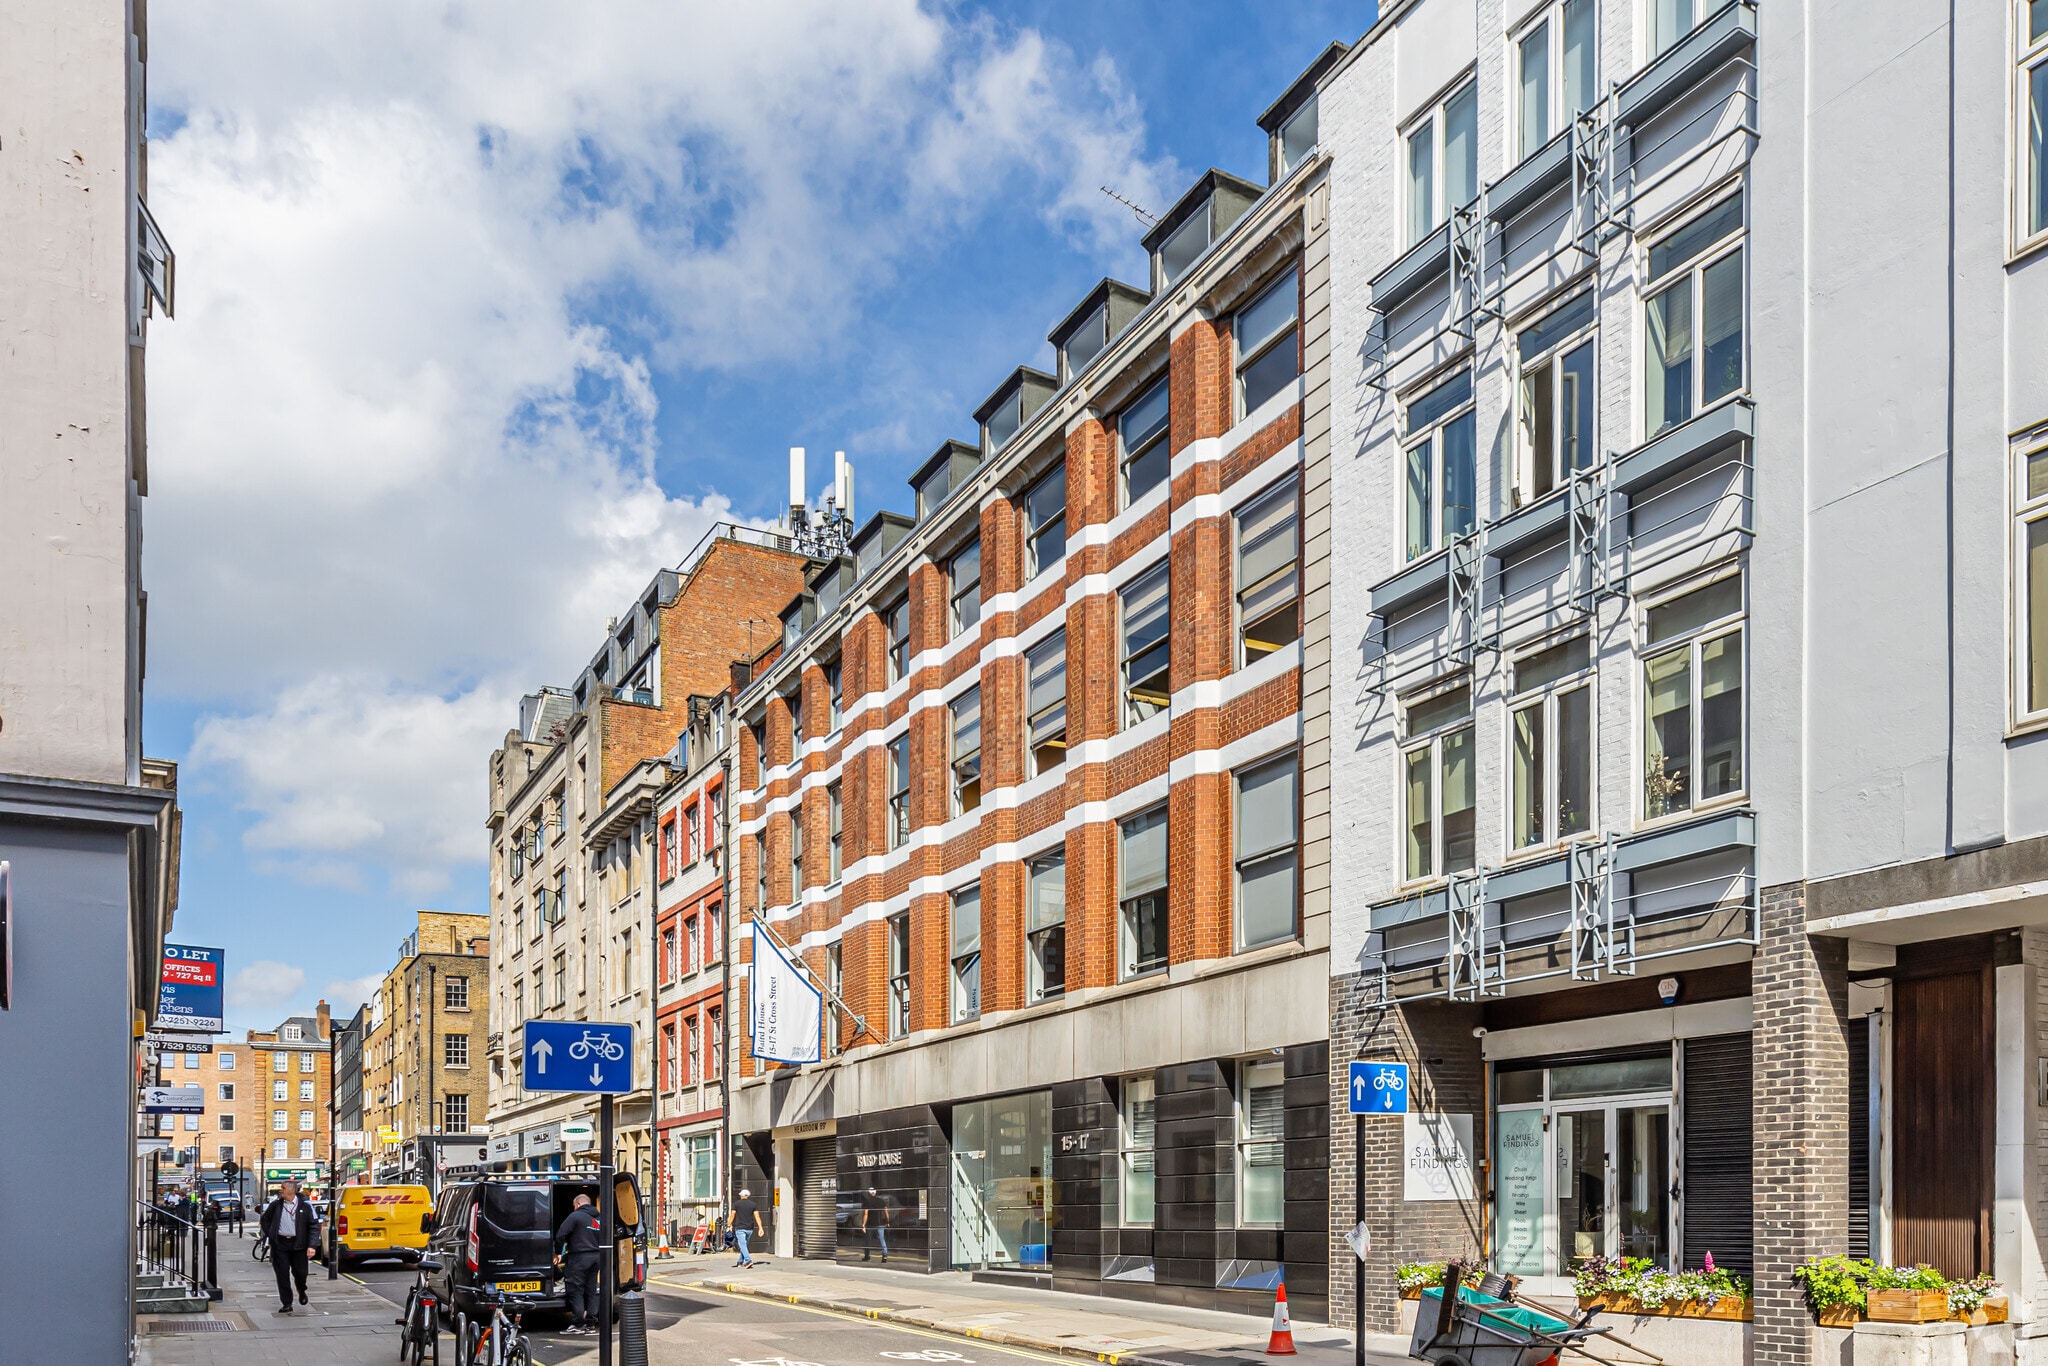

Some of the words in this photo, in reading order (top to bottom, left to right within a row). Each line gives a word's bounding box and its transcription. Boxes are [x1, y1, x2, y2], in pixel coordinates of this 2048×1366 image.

[182, 950, 210, 960] LET
[164, 964, 200, 972] OFFICES
[161, 984, 176, 994] vis
[160, 994, 176, 1004] ler
[160, 1004, 194, 1014] phens
[769, 1026, 776, 1034] St
[162, 1042, 184, 1050] 7529
[186, 1044, 208, 1052] 5555
[794, 1122, 818, 1134] HEADROOM
[533, 1133, 550, 1142] WALSH
[1416, 1146, 1464, 1158] SAMUEL
[858, 1154, 878, 1167] BAIRD
[879, 1152, 901, 1166] HOUSE
[1410, 1158, 1469, 1169] FINDINGS
[362, 1195, 414, 1205] DHL
[520, 1282, 537, 1290] WSD
